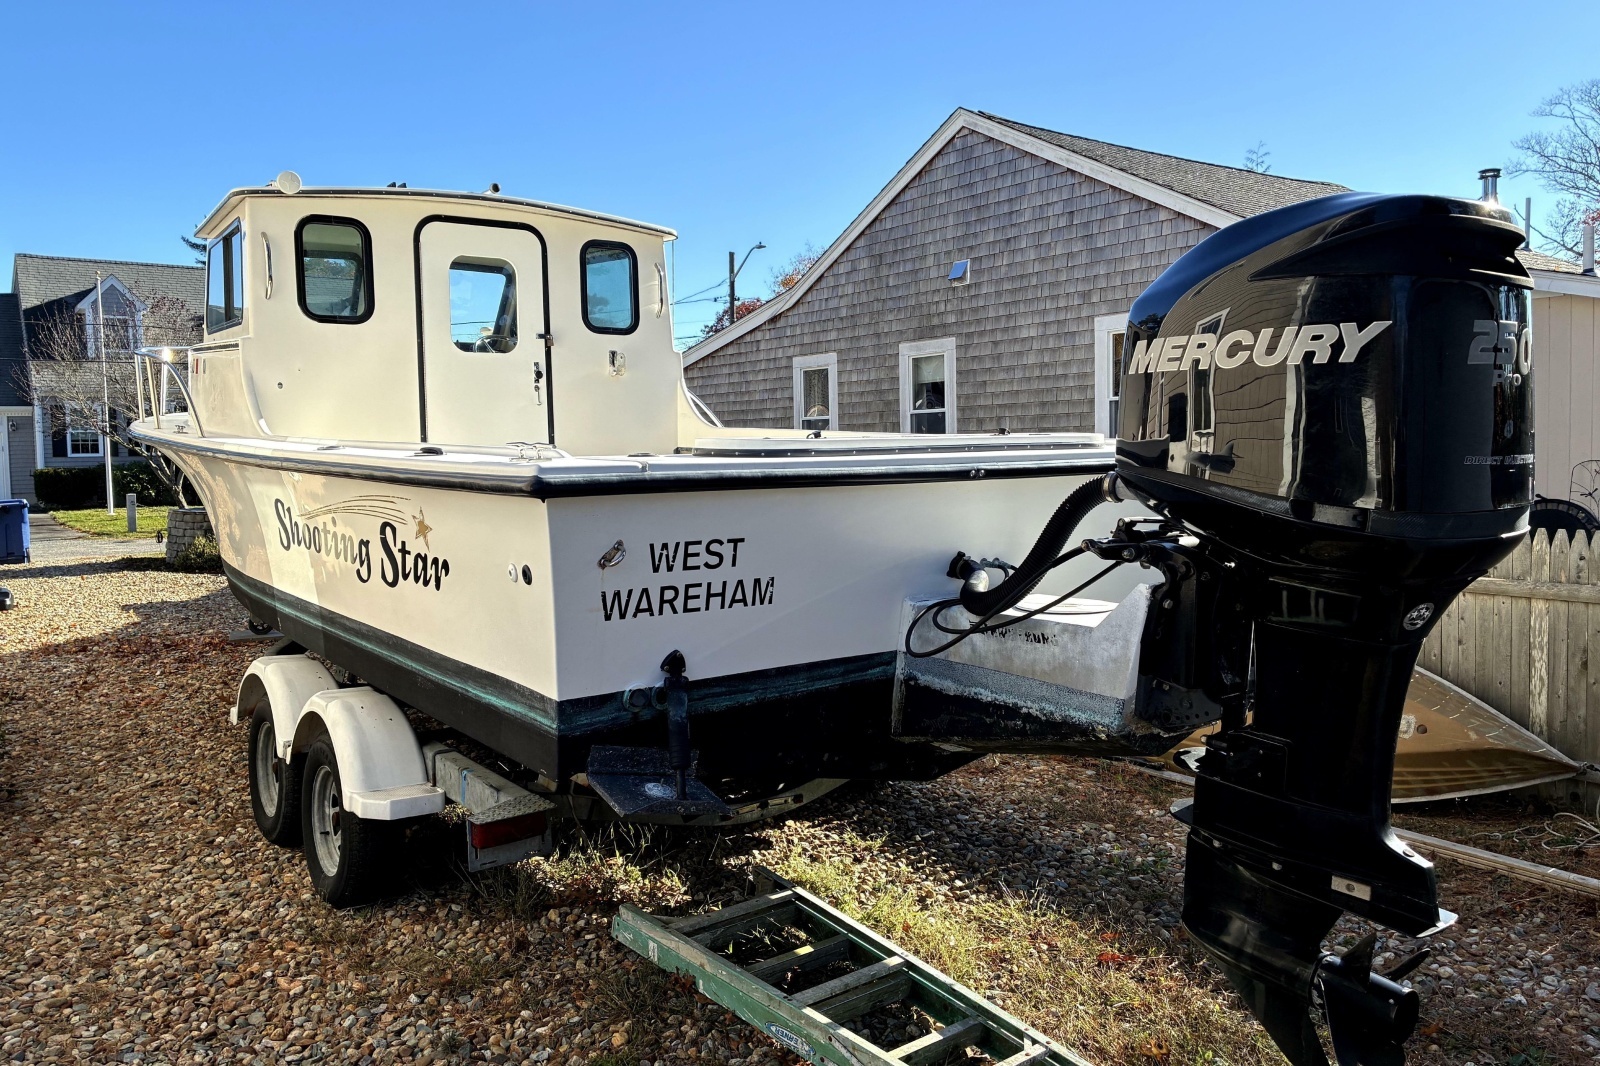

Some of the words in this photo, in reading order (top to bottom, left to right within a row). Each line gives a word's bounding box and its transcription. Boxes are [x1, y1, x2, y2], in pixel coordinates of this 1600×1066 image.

[1129, 320, 1393, 375] MERCURY
[1467, 319, 1533, 376] 250
[1464, 455, 1503, 465] DIRECT
[274, 498, 372, 584] Shooting
[379, 521, 450, 592] Star
[649, 537, 746, 574] WEST
[601, 576, 775, 622] WAREHAM
